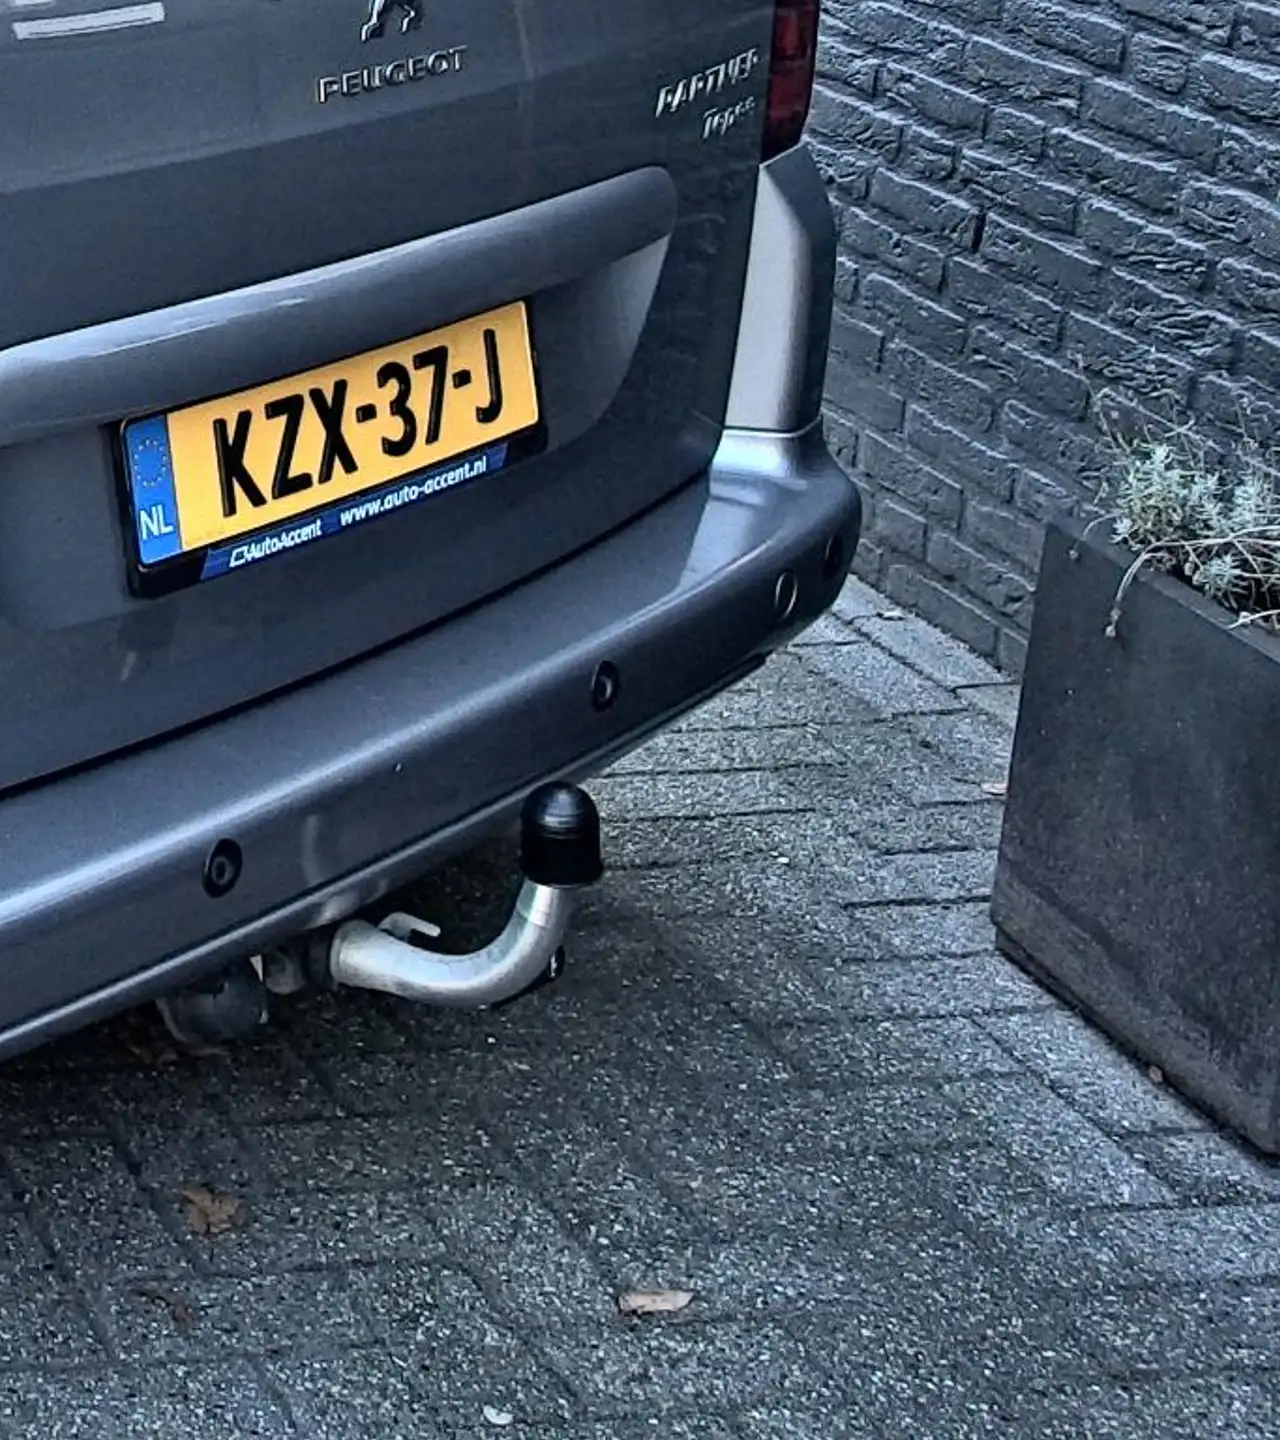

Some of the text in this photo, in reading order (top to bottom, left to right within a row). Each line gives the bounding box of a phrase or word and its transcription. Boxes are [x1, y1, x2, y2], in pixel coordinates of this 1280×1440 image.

[316, 44, 468, 103] PEUGEOT
[212, 327, 504, 518] KZX-37-J
[138, 503, 174, 541] NL
[245, 455, 487, 561] AutoAccent www.auto-accent.nl
